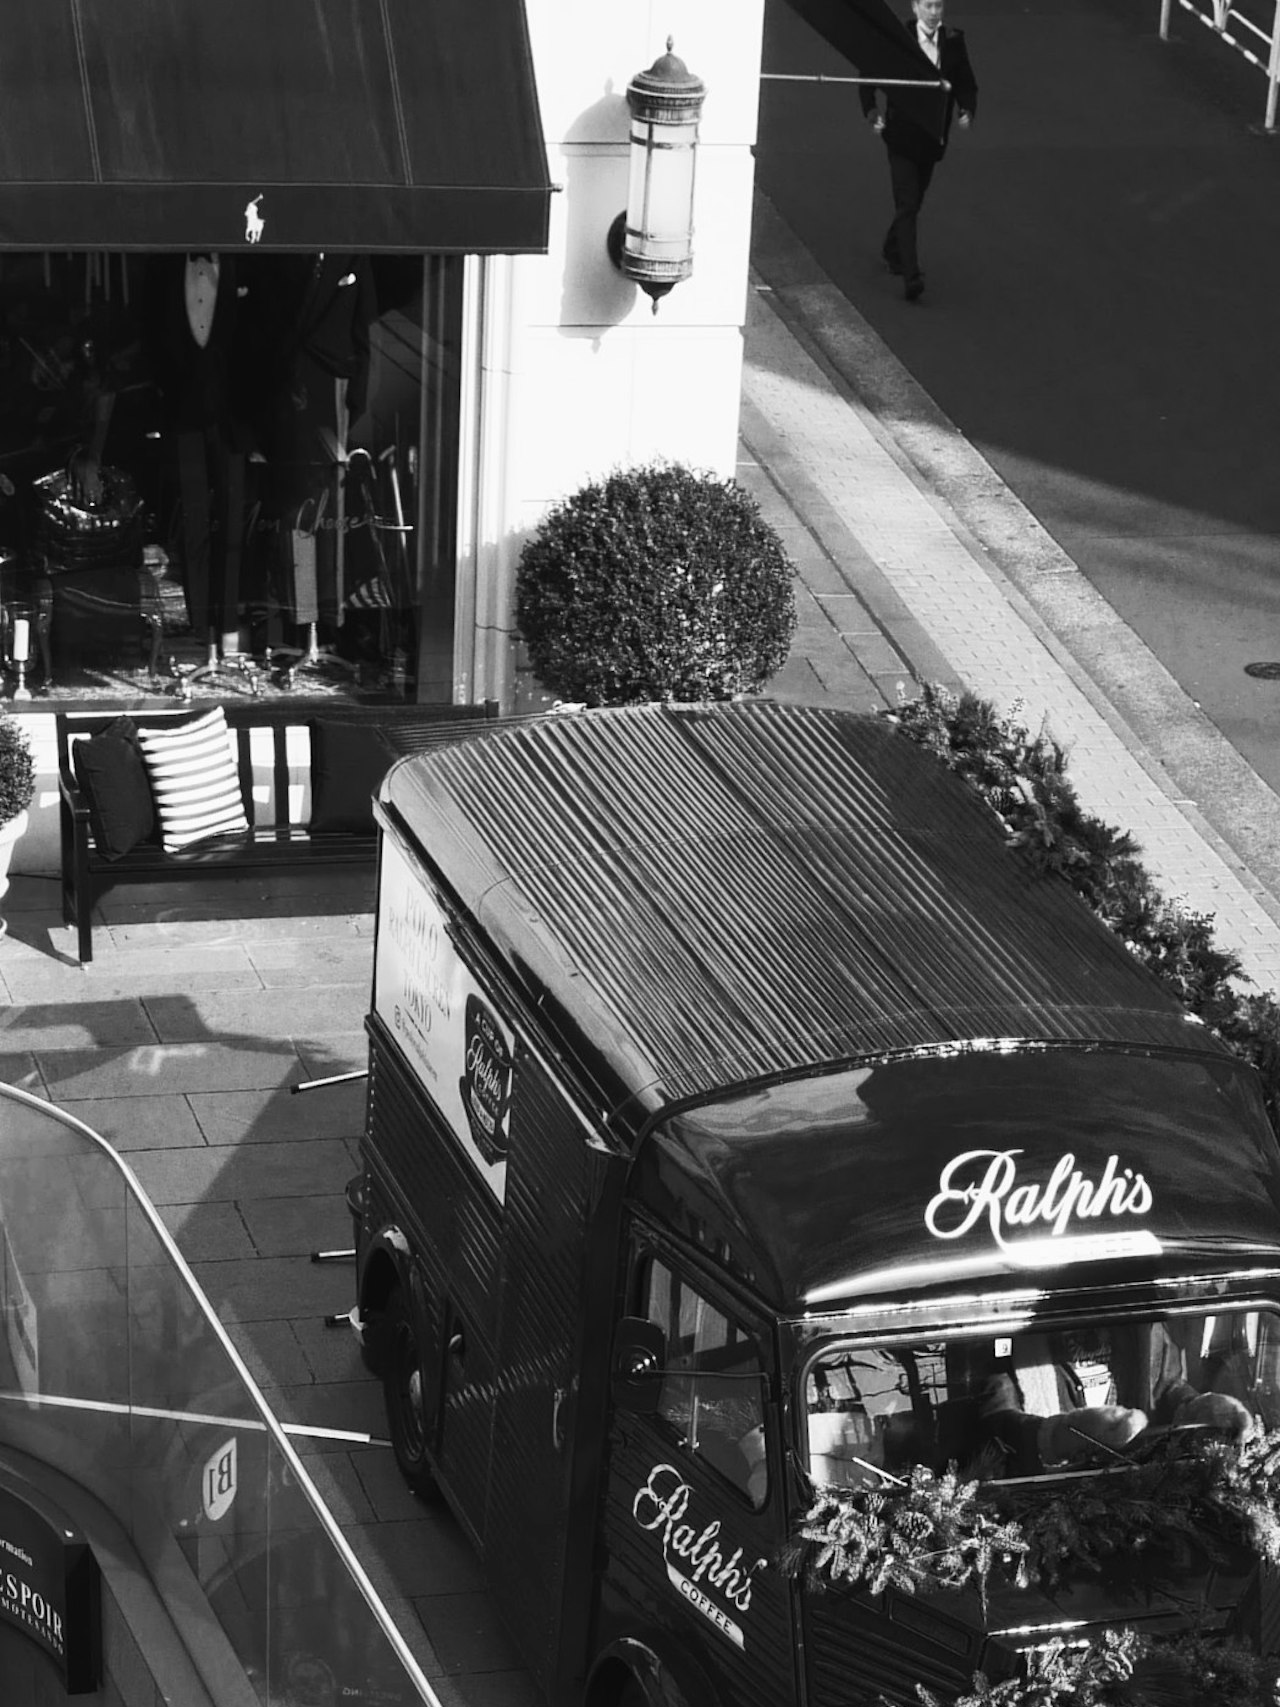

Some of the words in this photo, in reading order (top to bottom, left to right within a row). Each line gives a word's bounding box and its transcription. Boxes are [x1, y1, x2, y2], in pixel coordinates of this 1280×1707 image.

[925, 1149, 1154, 1250] Ralph's
[633, 1464, 754, 1611] Ralph's
[680, 1580, 732, 1635] COFFEE
